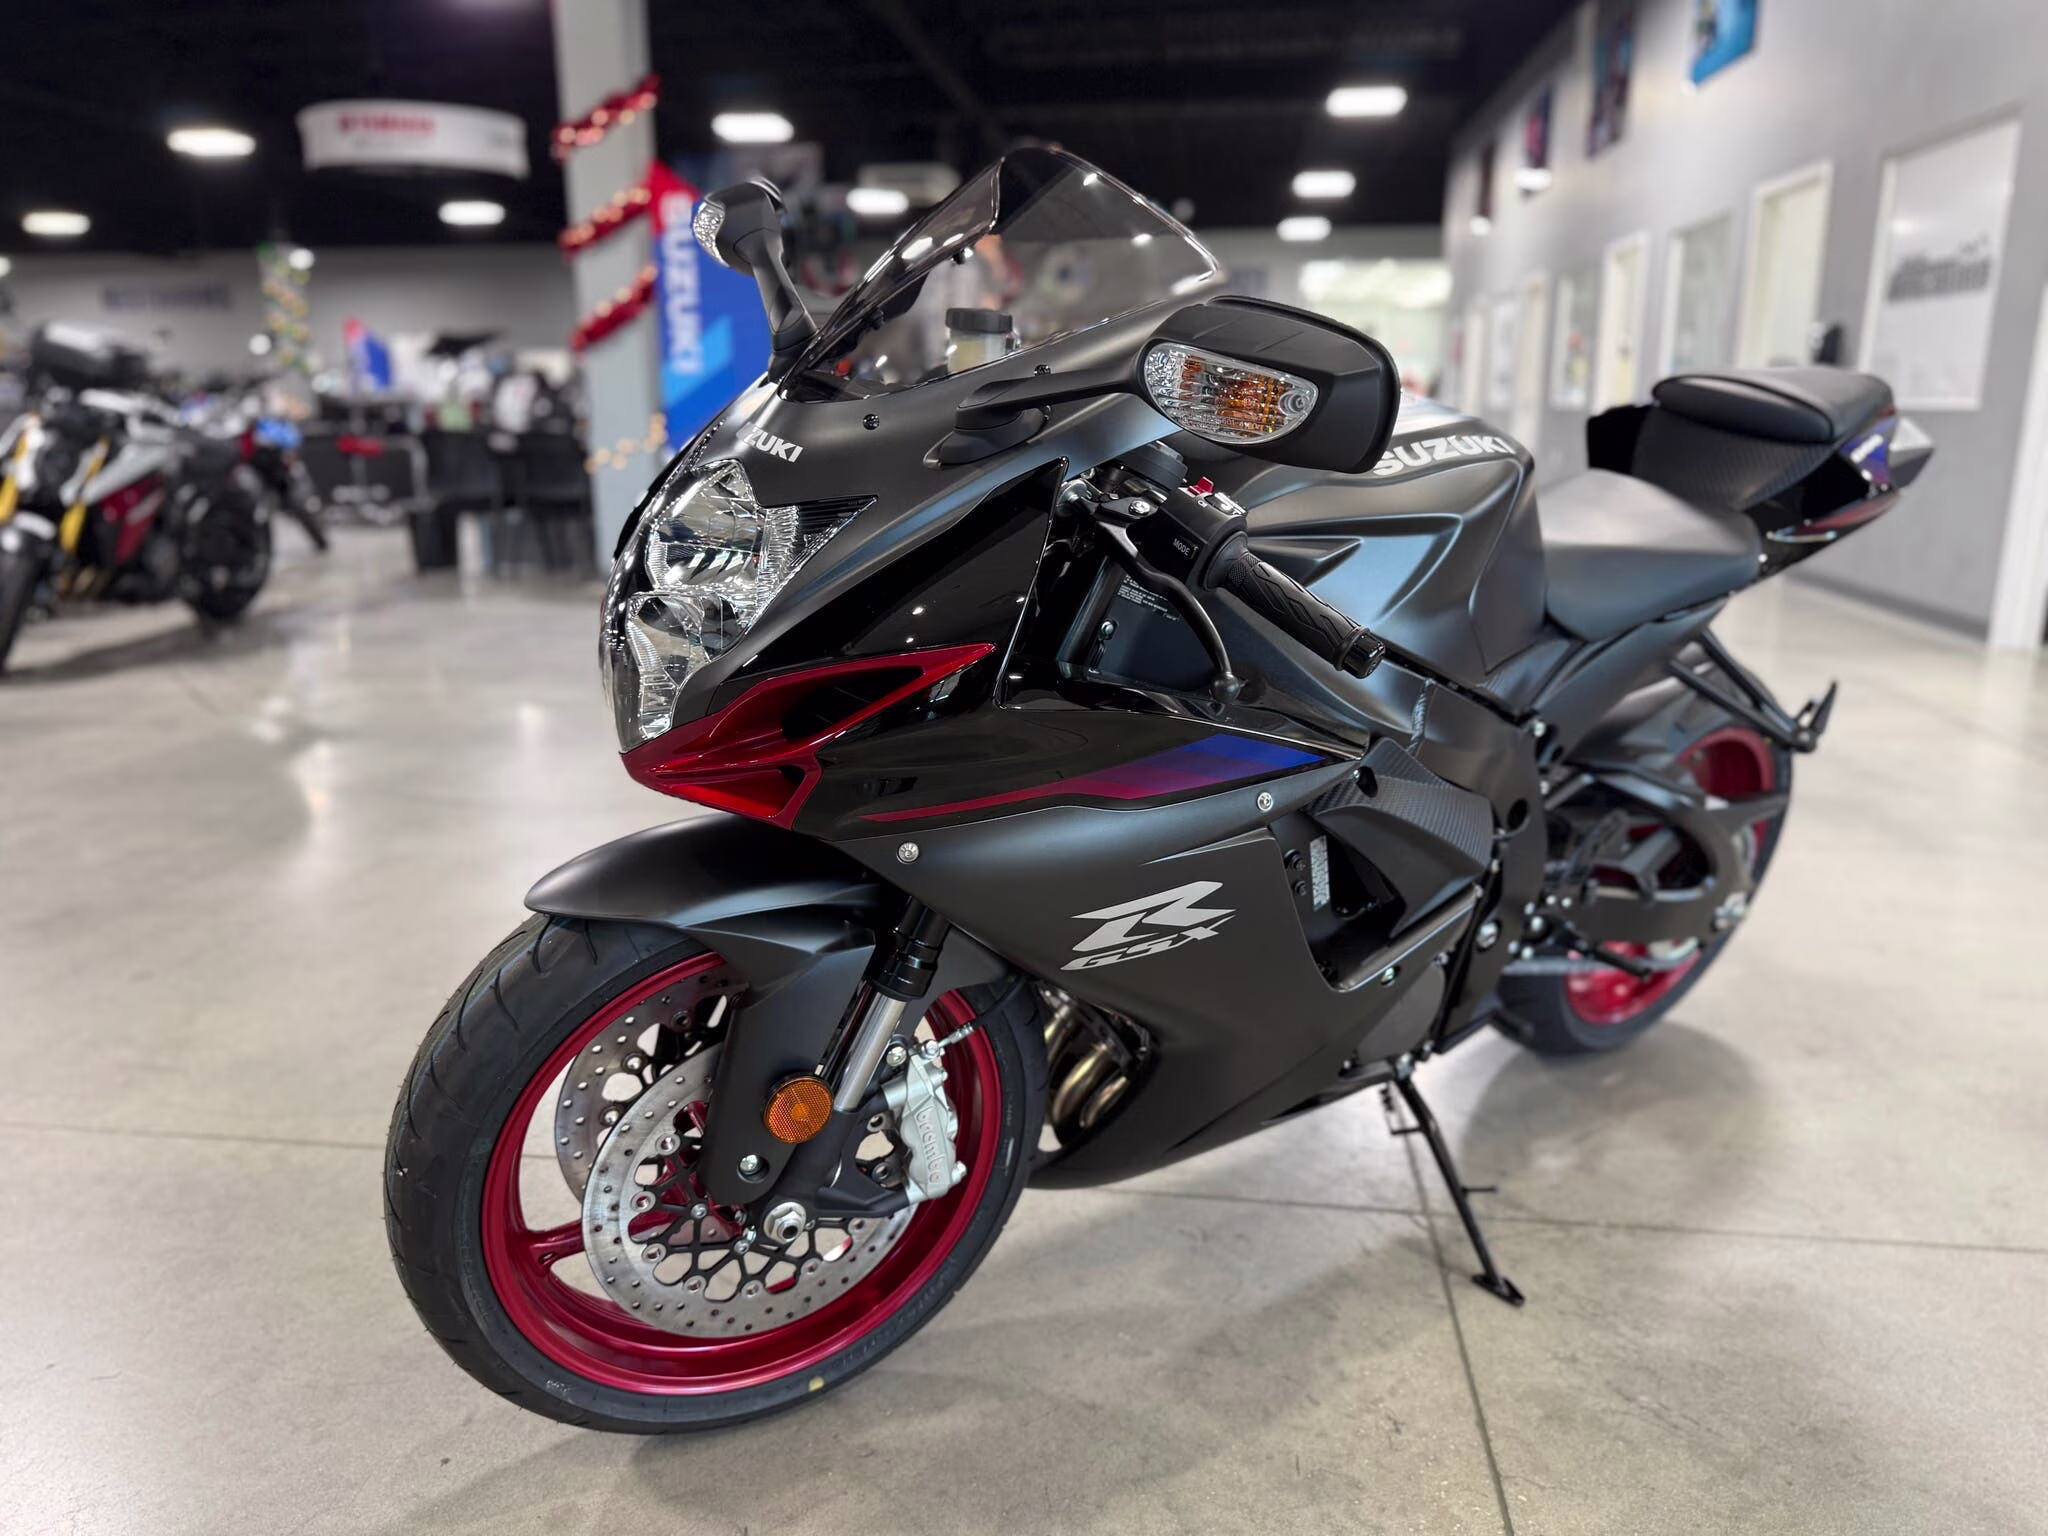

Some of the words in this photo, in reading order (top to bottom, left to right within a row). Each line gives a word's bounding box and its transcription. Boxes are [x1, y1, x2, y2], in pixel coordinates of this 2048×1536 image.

[1373, 435, 1516, 476] SUZUKI
[1173, 539, 1190, 556] MODE
[914, 1105, 946, 1185] brembo
